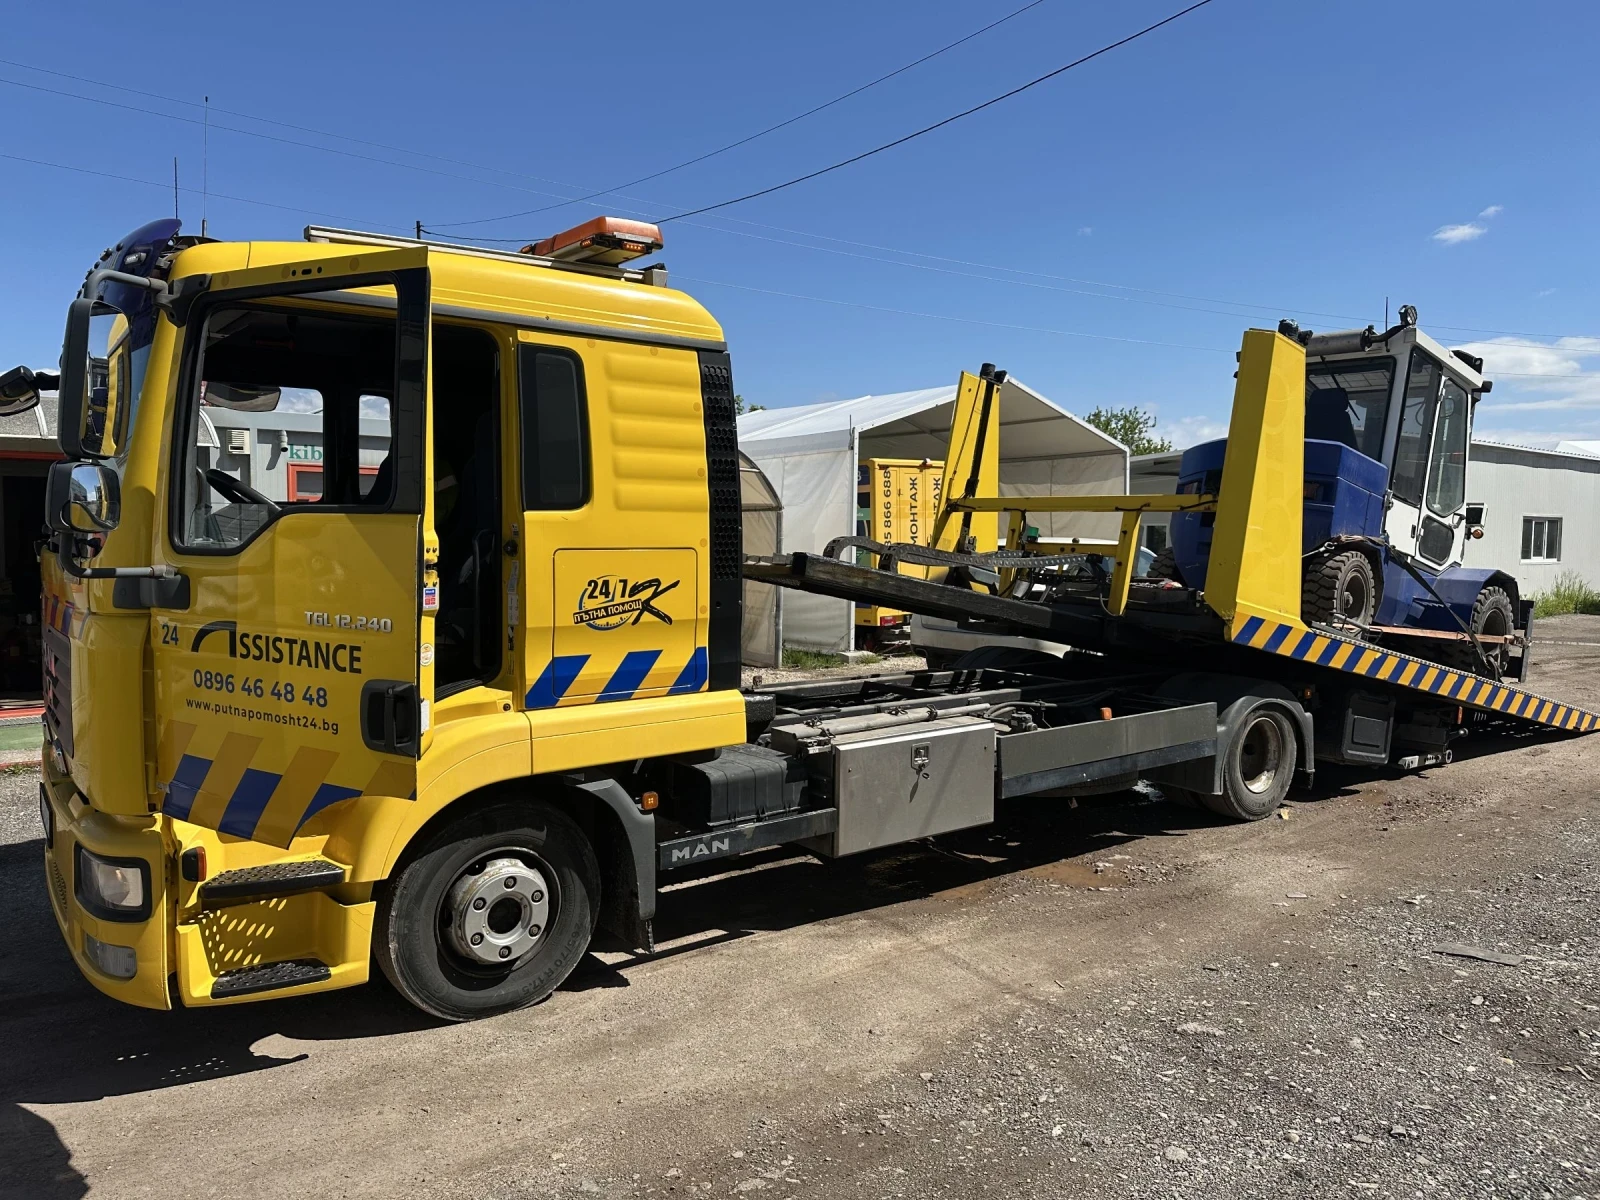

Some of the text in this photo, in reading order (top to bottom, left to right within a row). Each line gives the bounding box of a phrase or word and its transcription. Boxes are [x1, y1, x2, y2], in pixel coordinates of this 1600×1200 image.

[884, 501, 892, 528] 866
[304, 611, 392, 633] TGL 12.240
[574, 600, 642, 623] ПЪТНА ПОМОЩ
[161, 620, 363, 675] 24 ASSISTANCE
[193, 669, 328, 708] 0896 46 48 48
[186, 698, 340, 736] www.putnapomosht24.bg
[671, 837, 730, 862] MAN
